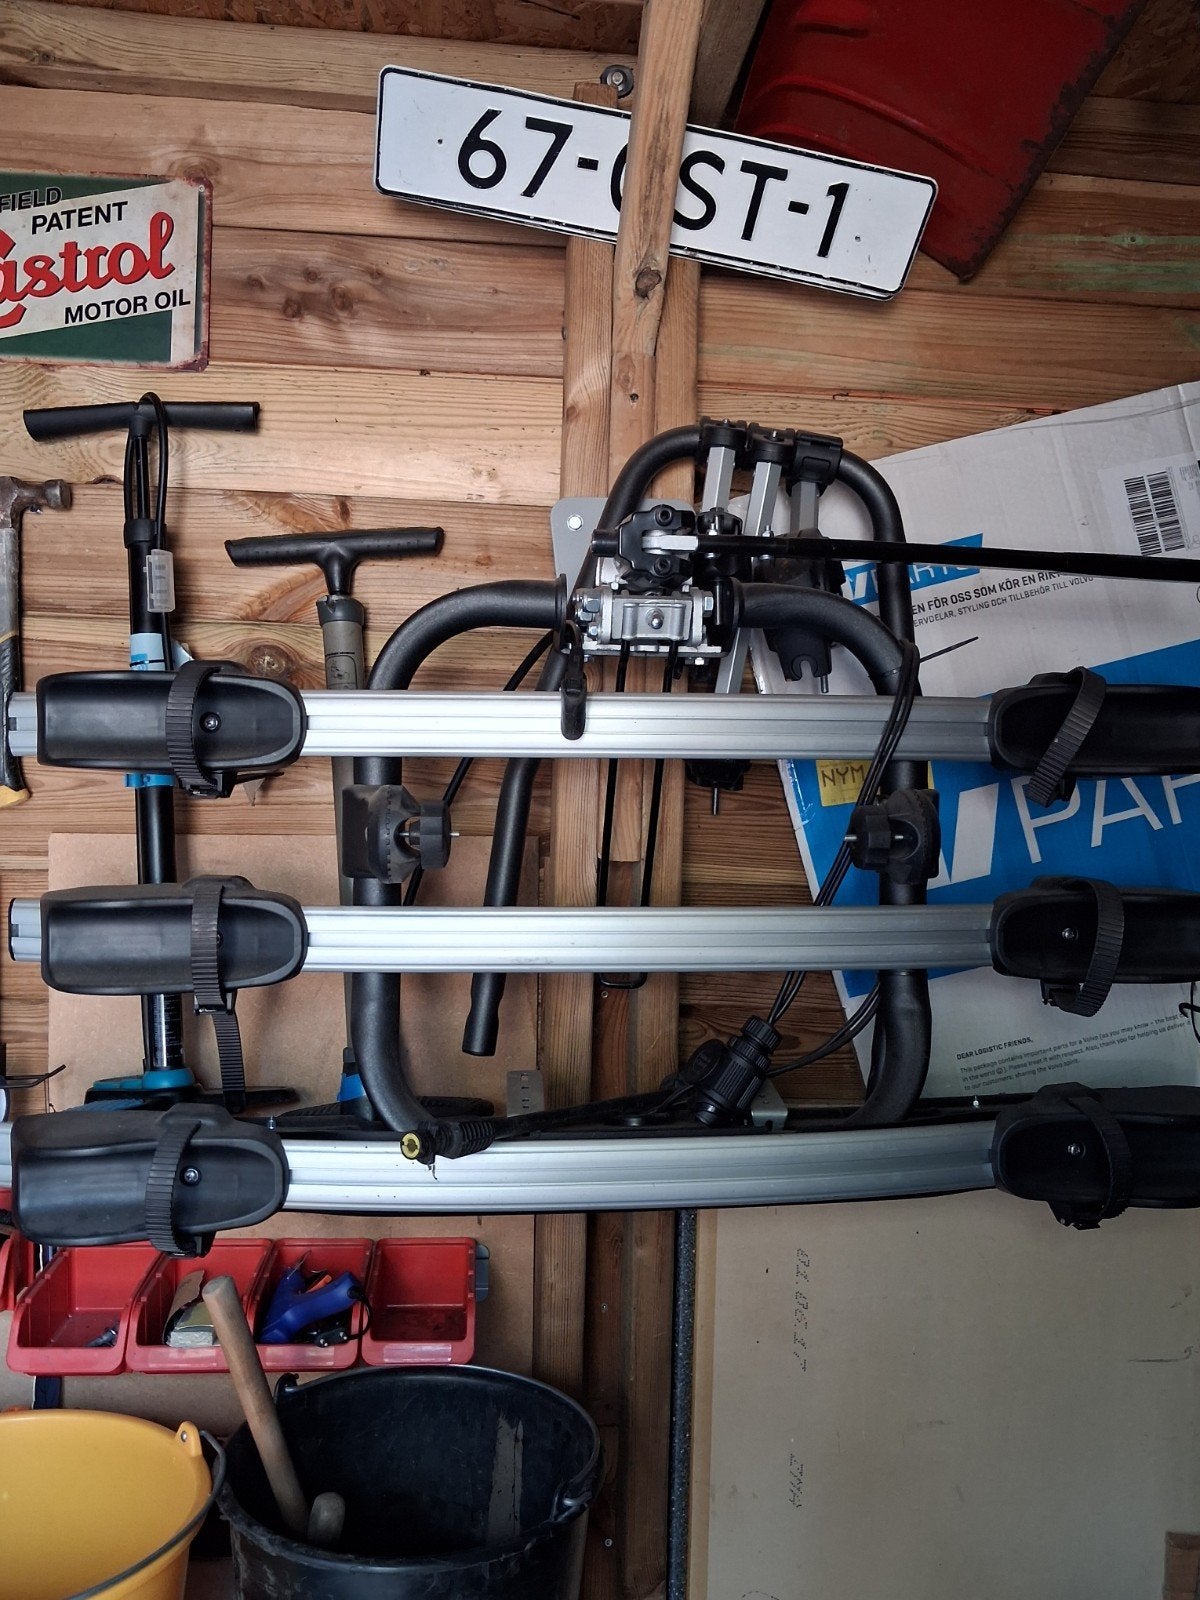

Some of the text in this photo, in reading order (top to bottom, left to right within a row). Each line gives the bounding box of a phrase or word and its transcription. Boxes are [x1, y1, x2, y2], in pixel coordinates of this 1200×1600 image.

[31, 201, 128, 235] PATENT
[0, 211, 175, 329] astrol
[64, 289, 191, 324] MOTOR OIL
[927, 596, 949, 611] FÖR
[950, 590, 972, 605] OSS
[973, 584, 998, 599] SOM
[998, 578, 1020, 592] KÖR
[1021, 574, 1036, 586] EN
[957, 601, 990, 615] STYLING
[991, 597, 1007, 607] OCH
[1008, 585, 1051, 602] TILLBEHÖR
[1051, 581, 1069, 591] TILL
[956, 1051, 974, 1060] DEAR
[974, 1043, 1004, 1056] LOGISTIC
[973, 1060, 997, 1073] package
